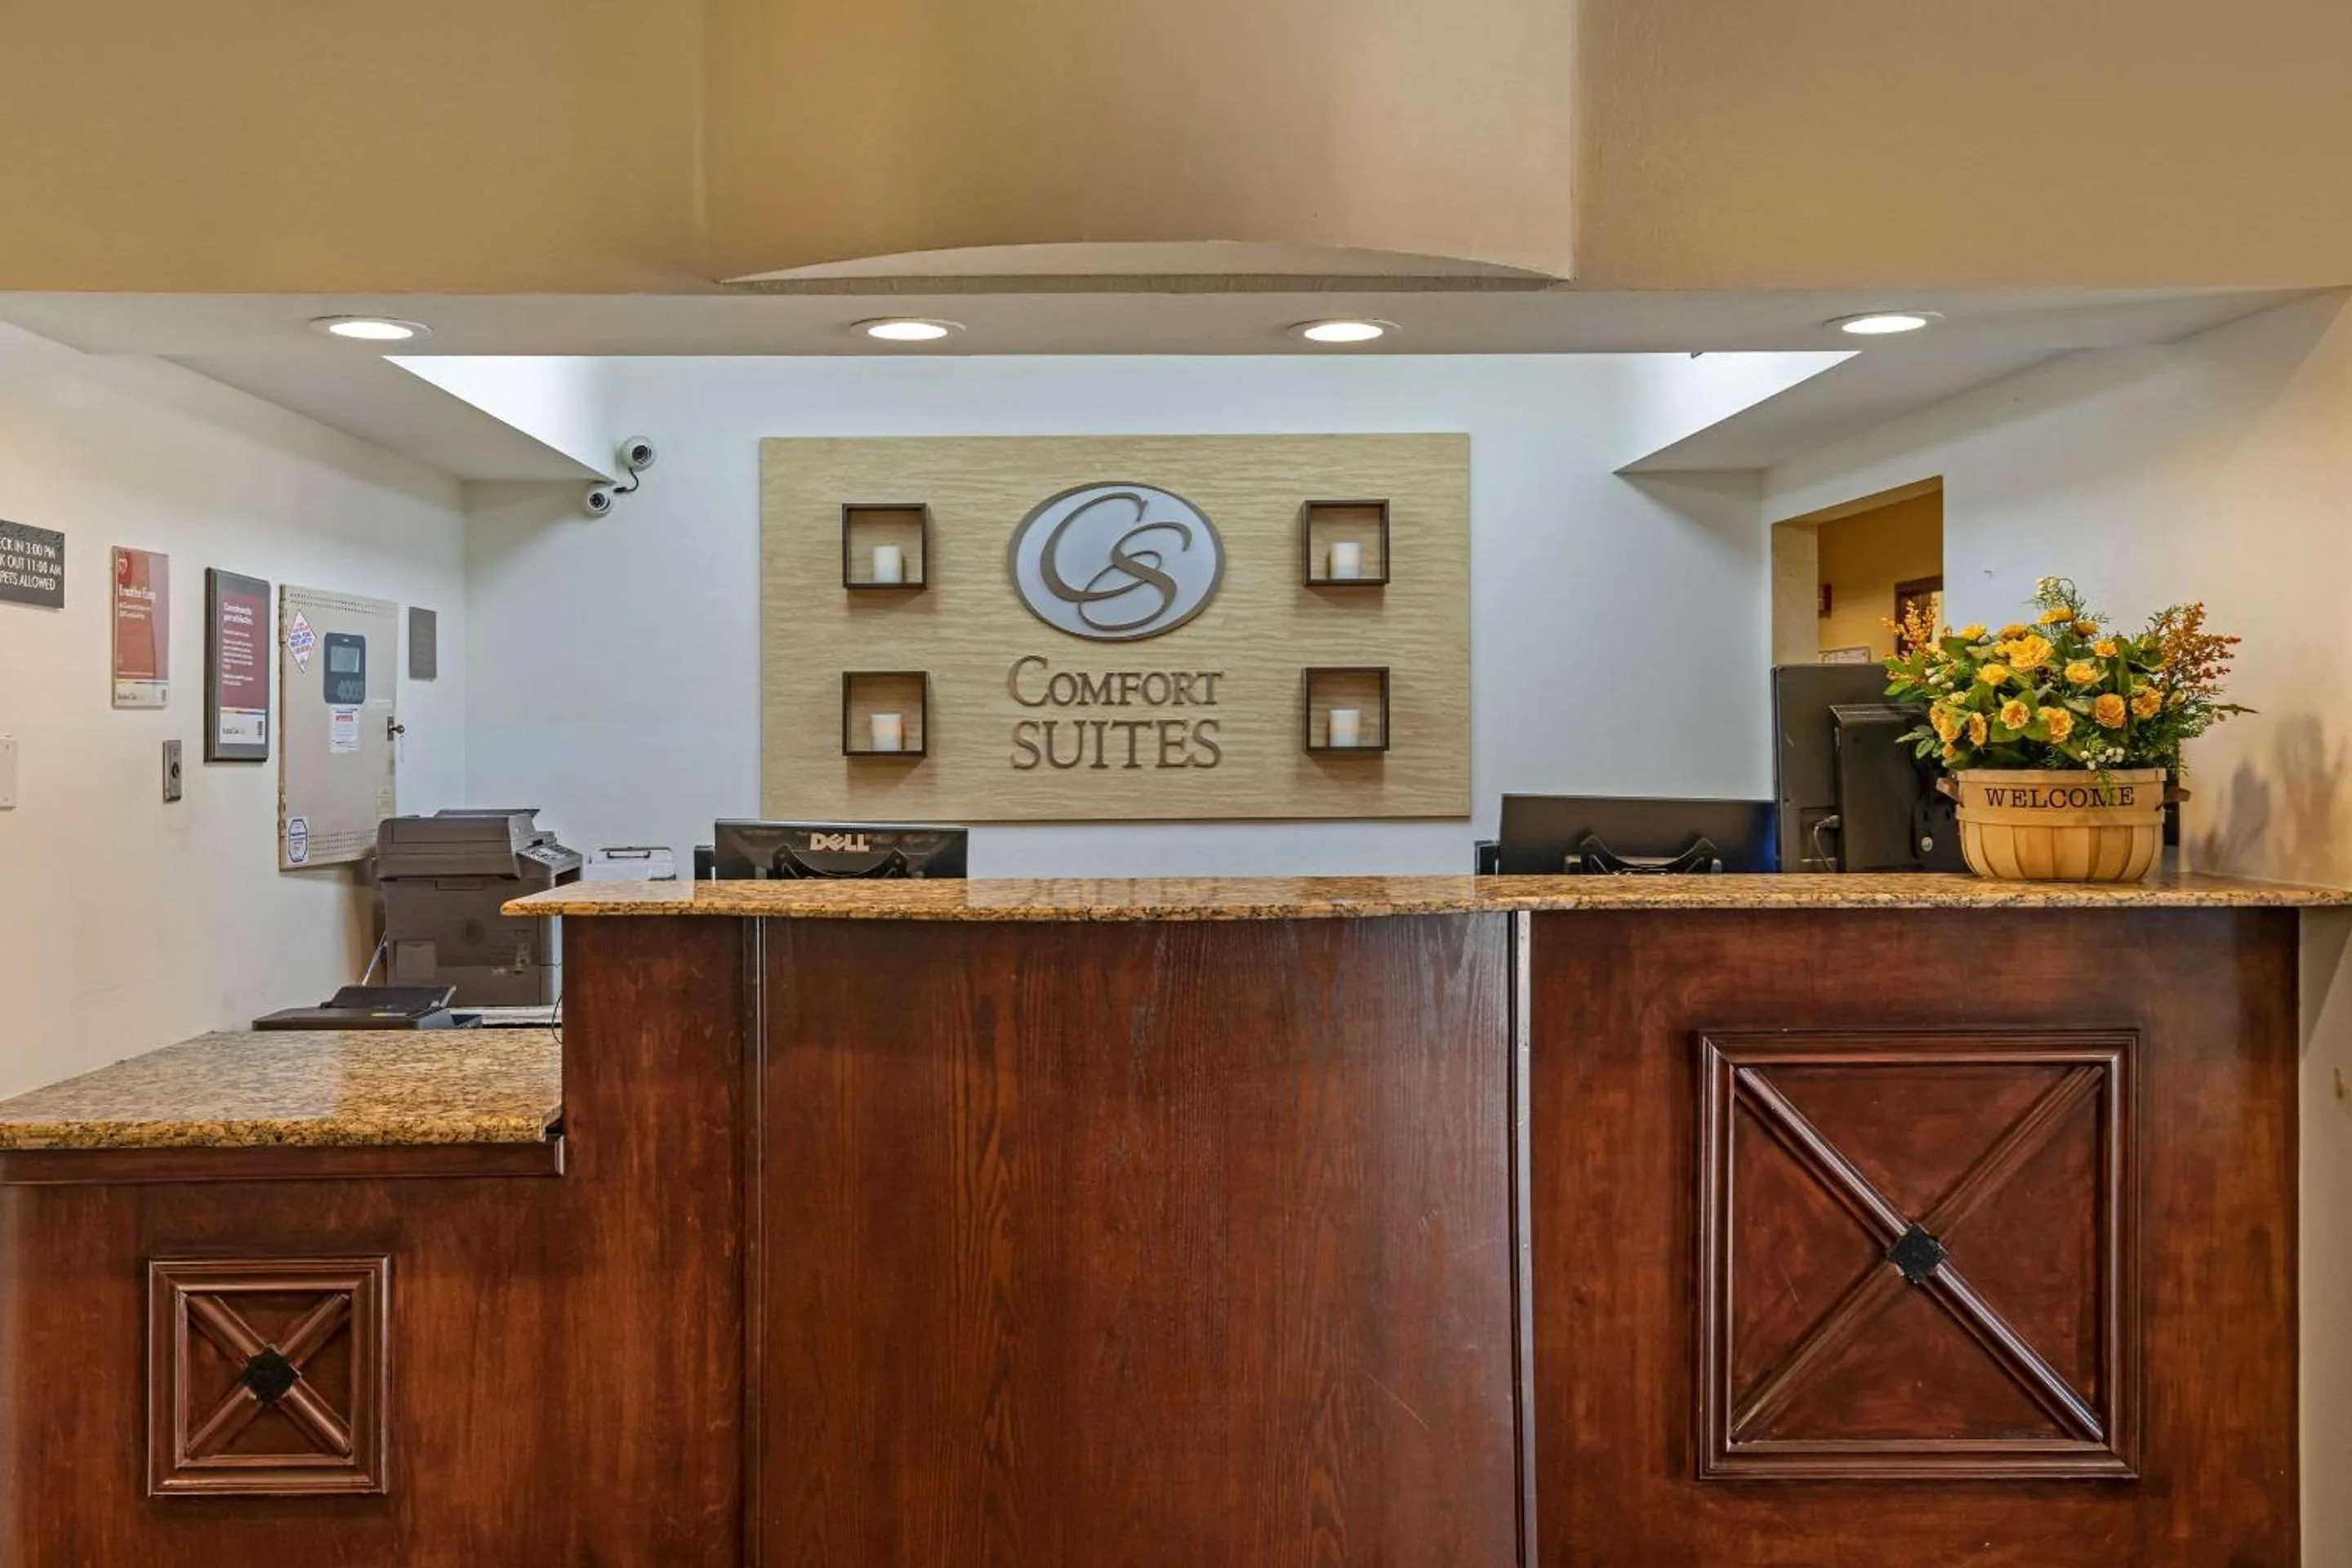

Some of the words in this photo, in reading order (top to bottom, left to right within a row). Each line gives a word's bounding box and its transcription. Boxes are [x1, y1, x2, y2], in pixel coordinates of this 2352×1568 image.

[0, 537, 13, 551] CK
[14, 540, 24, 553] IN
[25, 542, 43, 556] 3:00
[44, 546, 56, 559] PM
[7, 555, 25, 570] OUT
[27, 558, 48, 574] 11:00
[49, 564, 62, 576] AM
[19, 574, 56, 590] ALLOWED
[1007, 655, 1223, 706] COMFORT
[1010, 719, 1222, 768] SUITES
[1984, 786, 2134, 808] WELCOME
[810, 833, 870, 852] DELL
